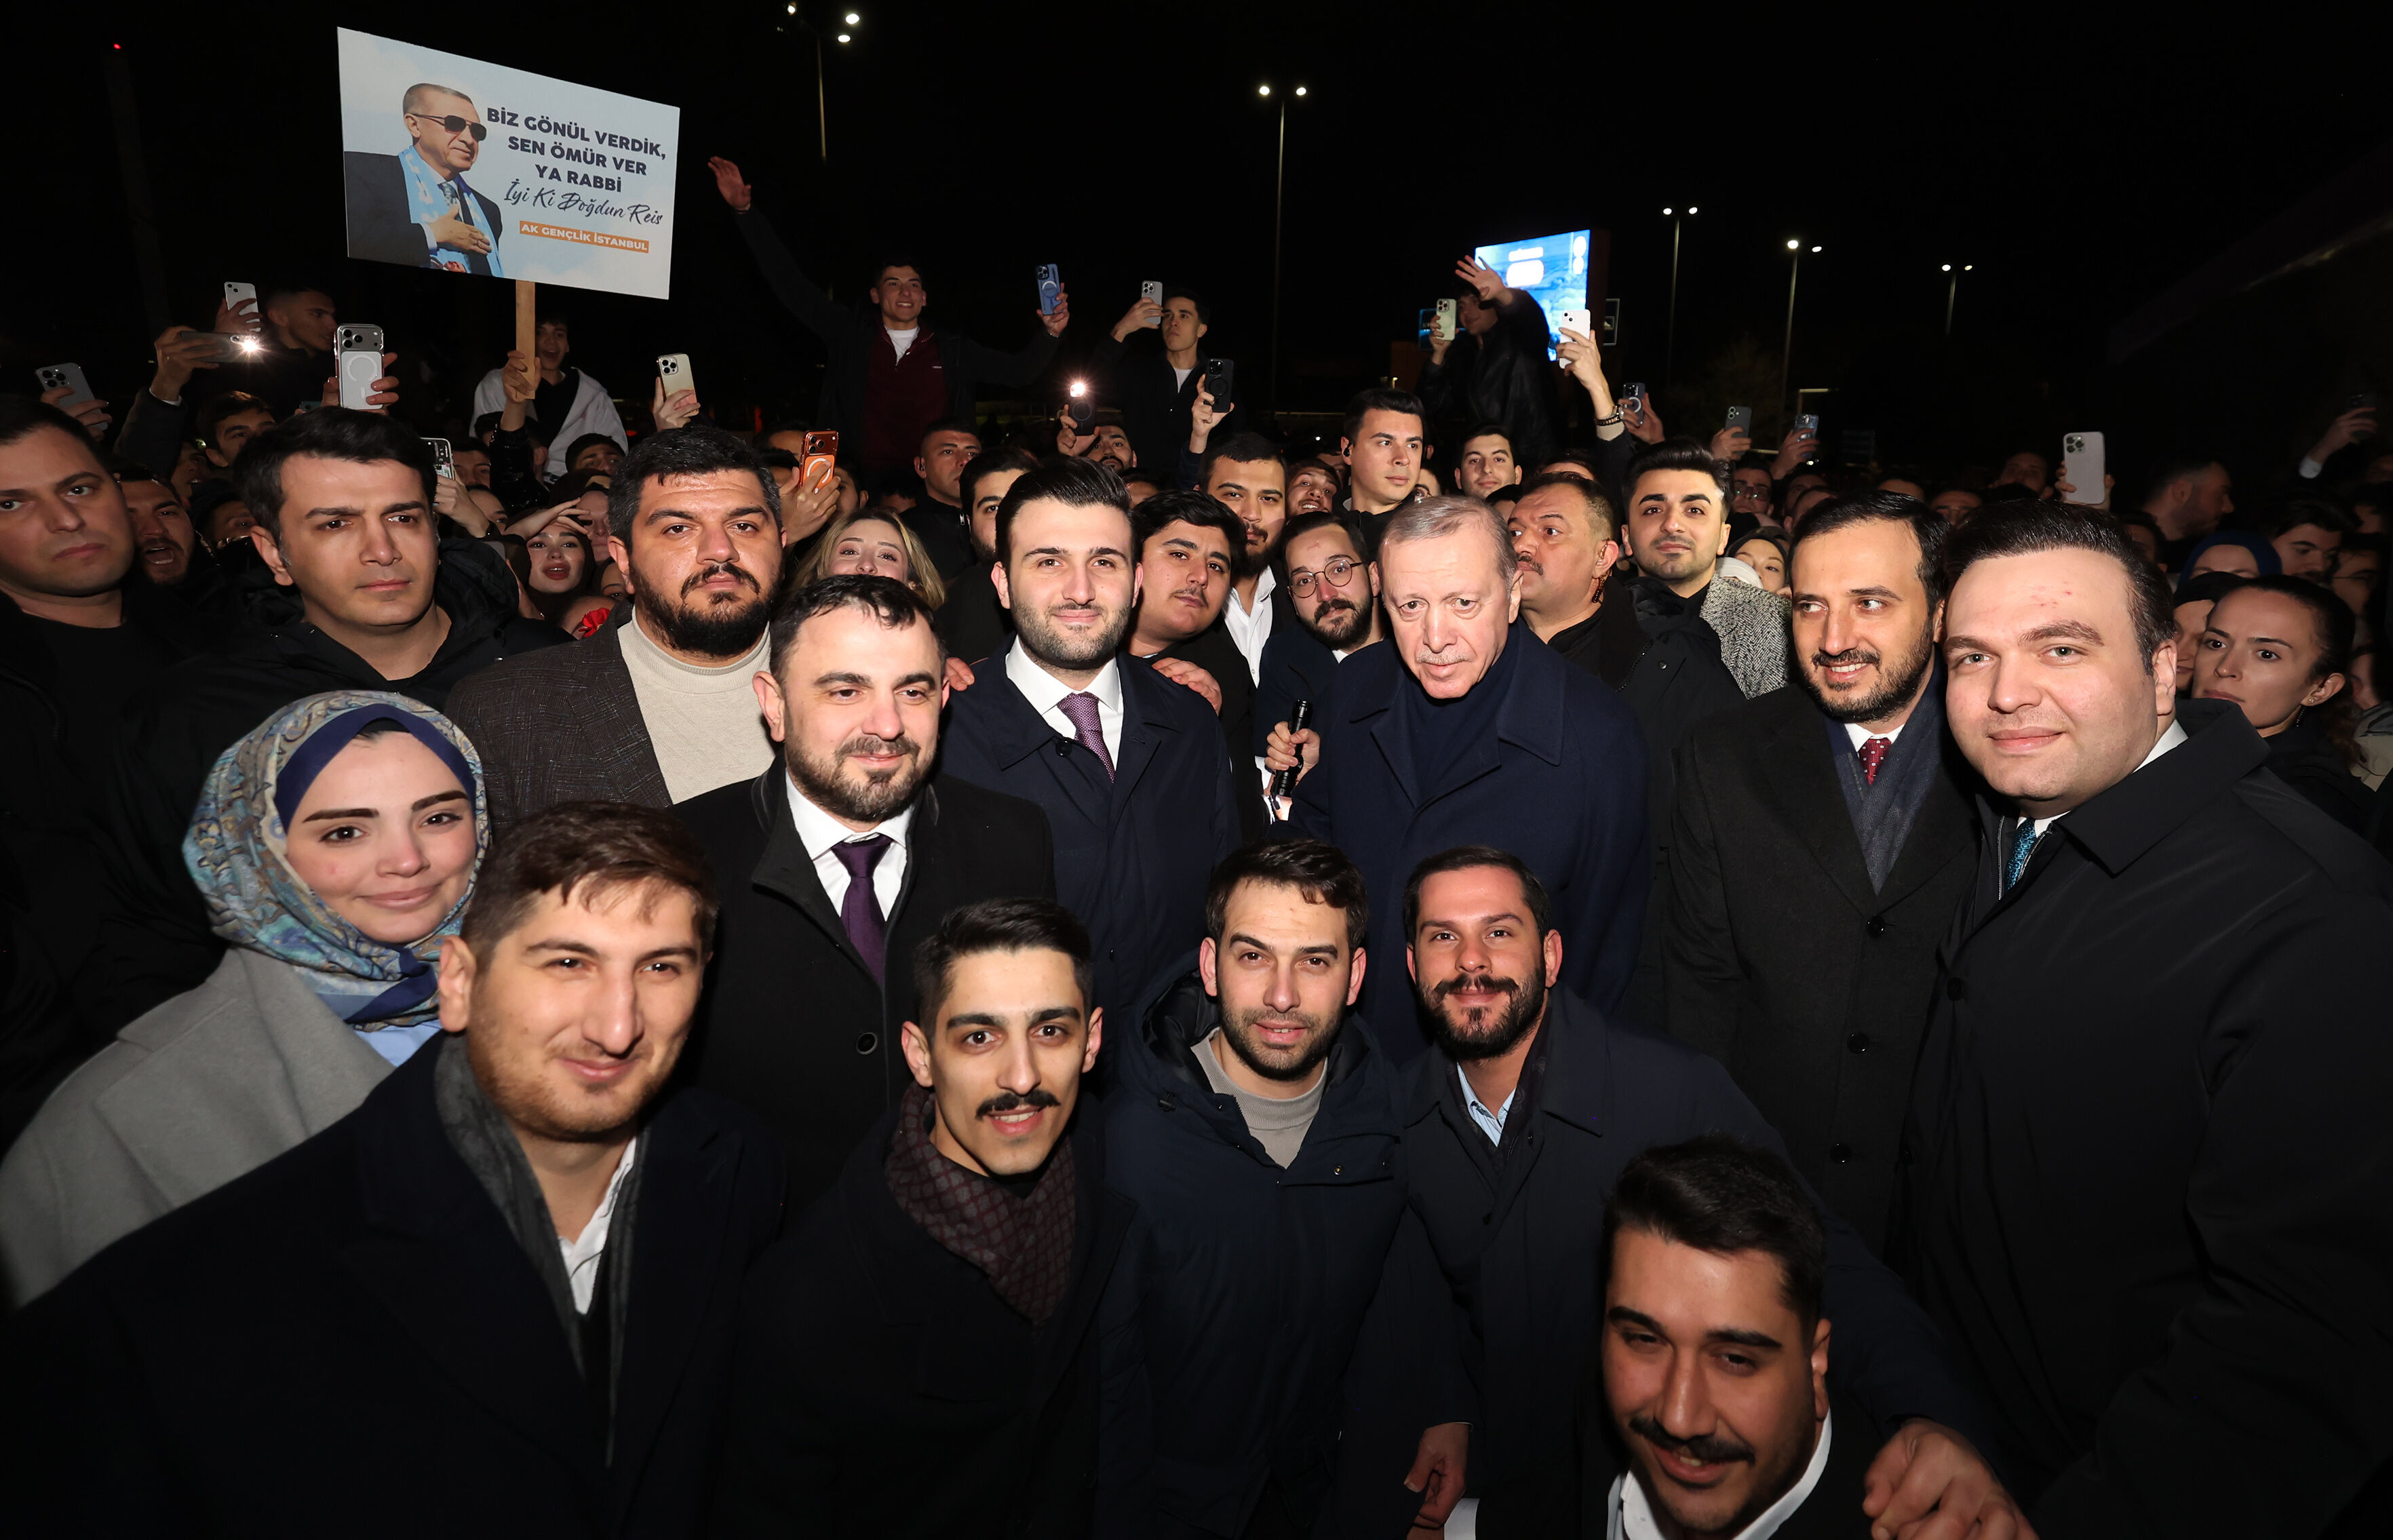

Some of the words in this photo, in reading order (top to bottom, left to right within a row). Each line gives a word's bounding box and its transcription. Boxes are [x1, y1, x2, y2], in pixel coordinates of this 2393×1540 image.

[487, 106, 519, 127] BİZ
[524, 115, 590, 142] GÖNÜL
[594, 130, 666, 160] VERDİK,
[507, 136, 545, 156] SEN
[550, 141, 607, 168] ÖMÜR
[612, 156, 647, 176] VER
[534, 163, 562, 182] YA
[567, 170, 621, 193] RABBİ
[503, 178, 530, 205] İyi
[532, 187, 556, 208] Ki
[557, 192, 625, 218] Doğdun
[627, 203, 663, 225] Reis
[521, 224, 540, 233] AK
[541, 227, 591, 242] GENÇLİK
[594, 231, 648, 251] İSTANBUL
